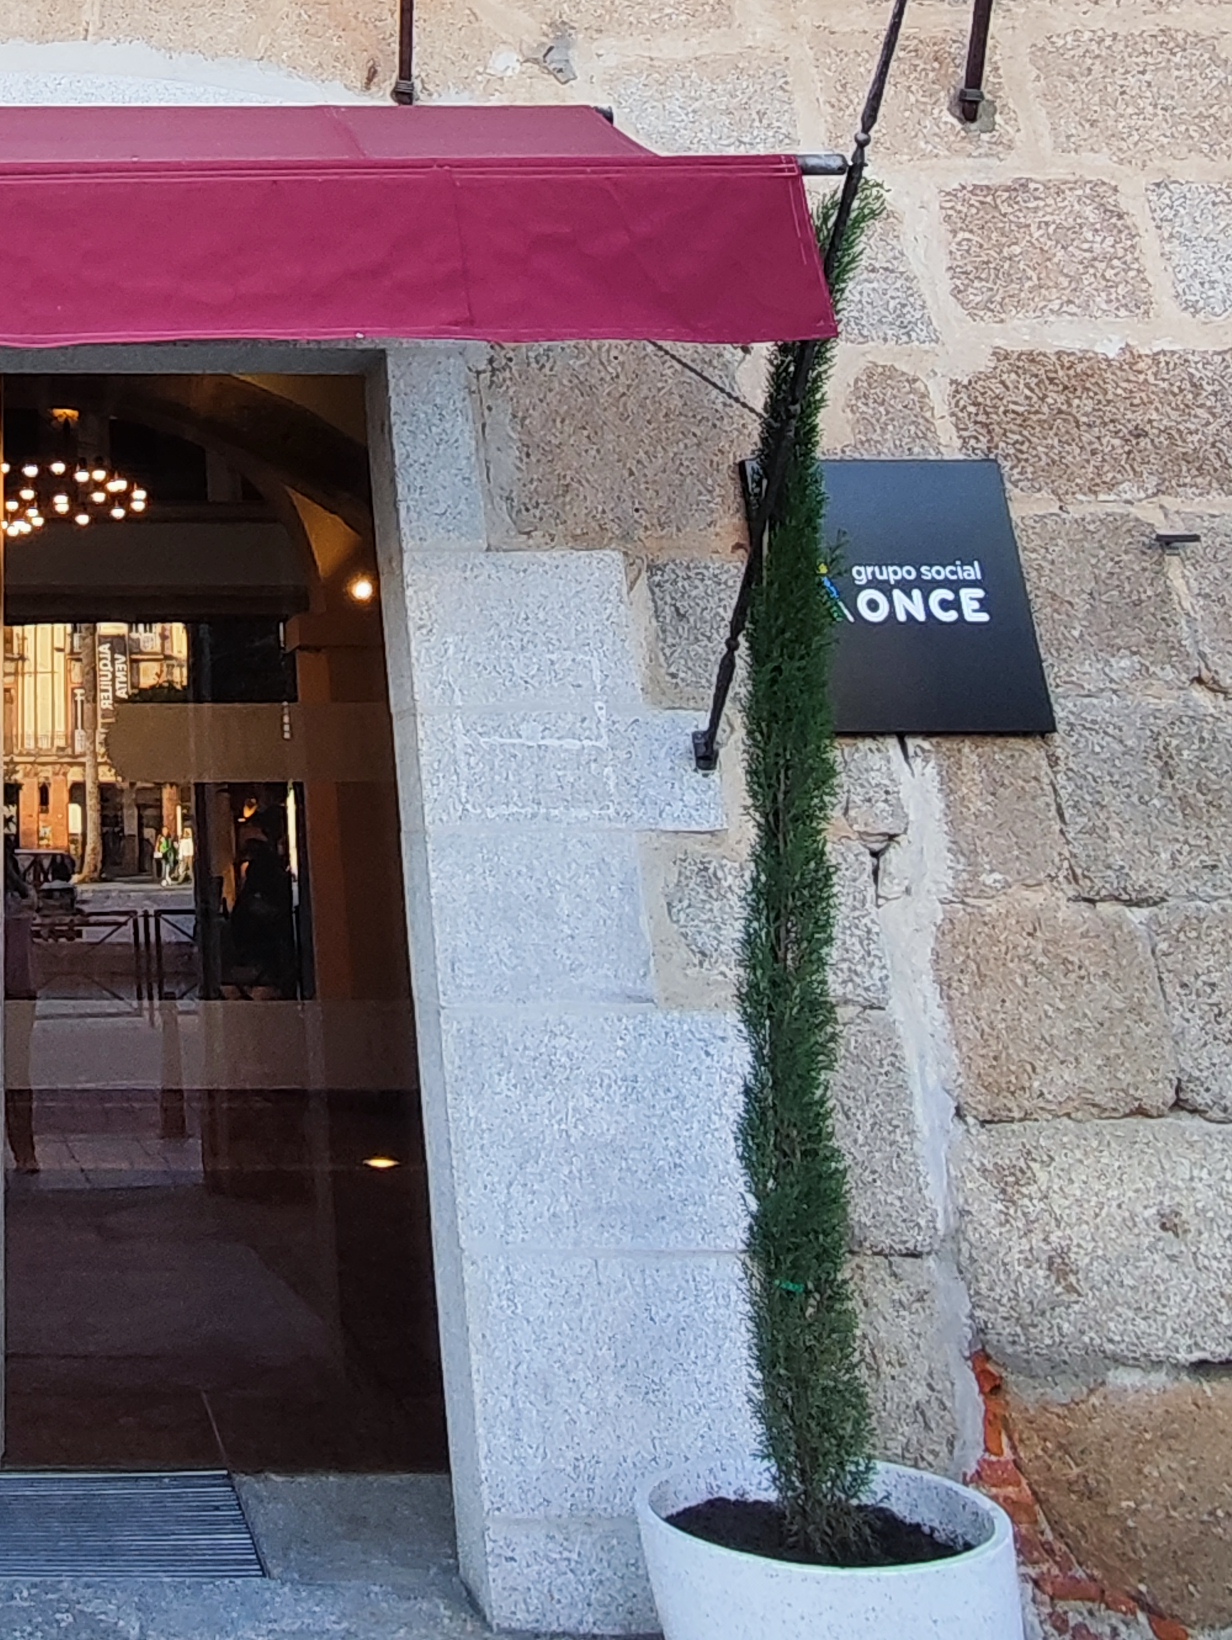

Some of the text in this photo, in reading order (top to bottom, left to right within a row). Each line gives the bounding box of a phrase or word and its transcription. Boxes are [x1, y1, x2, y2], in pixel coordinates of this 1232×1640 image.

[851, 560, 982, 585] grupo social
[856, 587, 991, 623] ONCE
